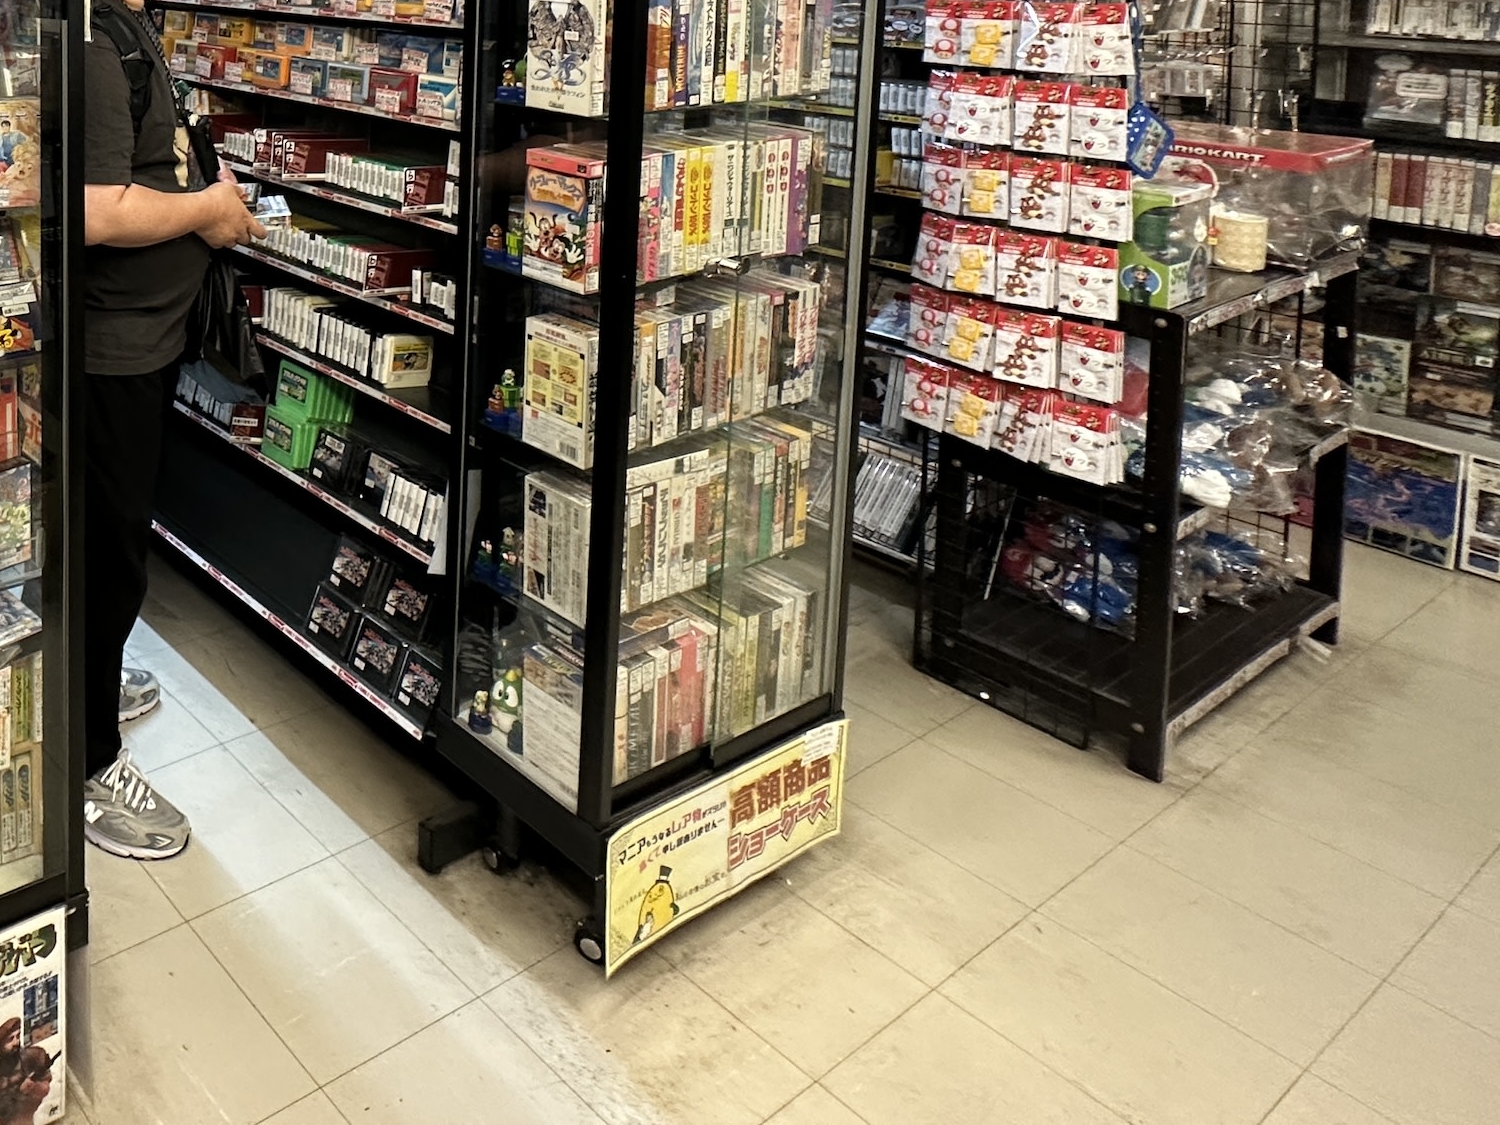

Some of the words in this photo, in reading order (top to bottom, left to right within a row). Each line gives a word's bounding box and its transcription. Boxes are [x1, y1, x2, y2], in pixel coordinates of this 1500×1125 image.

[675, 44, 687, 92] WOLVERINE
[727, 784, 833, 873] ショーケース
[728, 754, 832, 829] 高額商品
